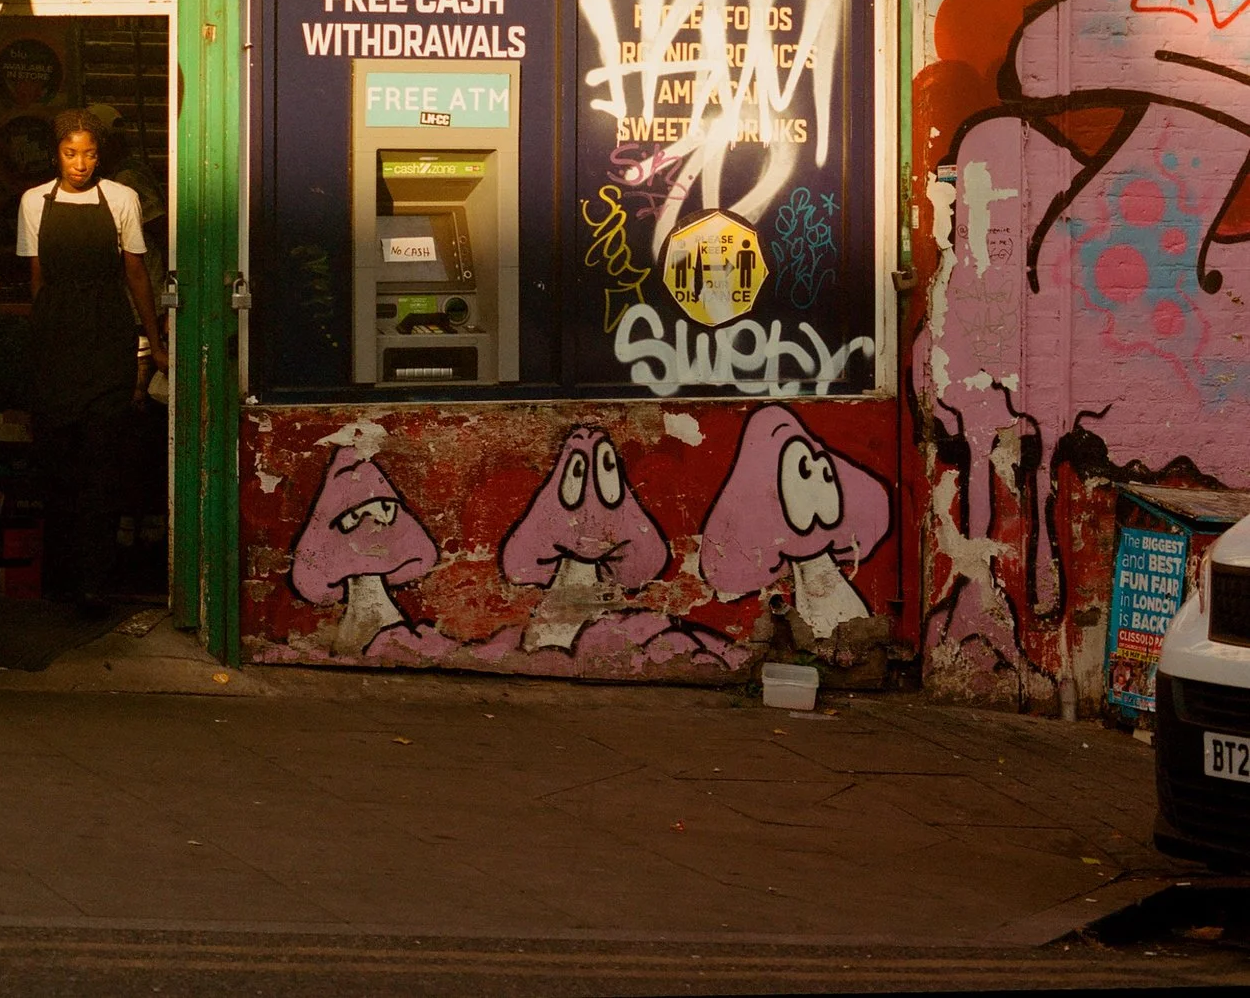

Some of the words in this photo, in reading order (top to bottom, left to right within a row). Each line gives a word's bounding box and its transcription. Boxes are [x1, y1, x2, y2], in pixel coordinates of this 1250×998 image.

[302, 23, 526, 58] WITHDRAWALS
[367, 87, 437, 111] FREE
[450, 87, 510, 112] ATM
[617, 118, 707, 142] SWEET
[404, 247, 430, 257] CASH
[1124, 533, 1140, 548] The
[1142, 536, 1184, 555] BIGGEST
[1121, 553, 1145, 570] and
[1148, 554, 1182, 575] BEST
[1119, 570, 1148, 592] FUN
[1151, 575, 1179, 597] FAIR
[1120, 591, 1130, 608] in
[1133, 594, 1177, 615] LONDON
[1119, 609, 1128, 627] is
[1119, 630, 1154, 646] CLISSOLD
[1212, 739, 1250, 778] BT2
